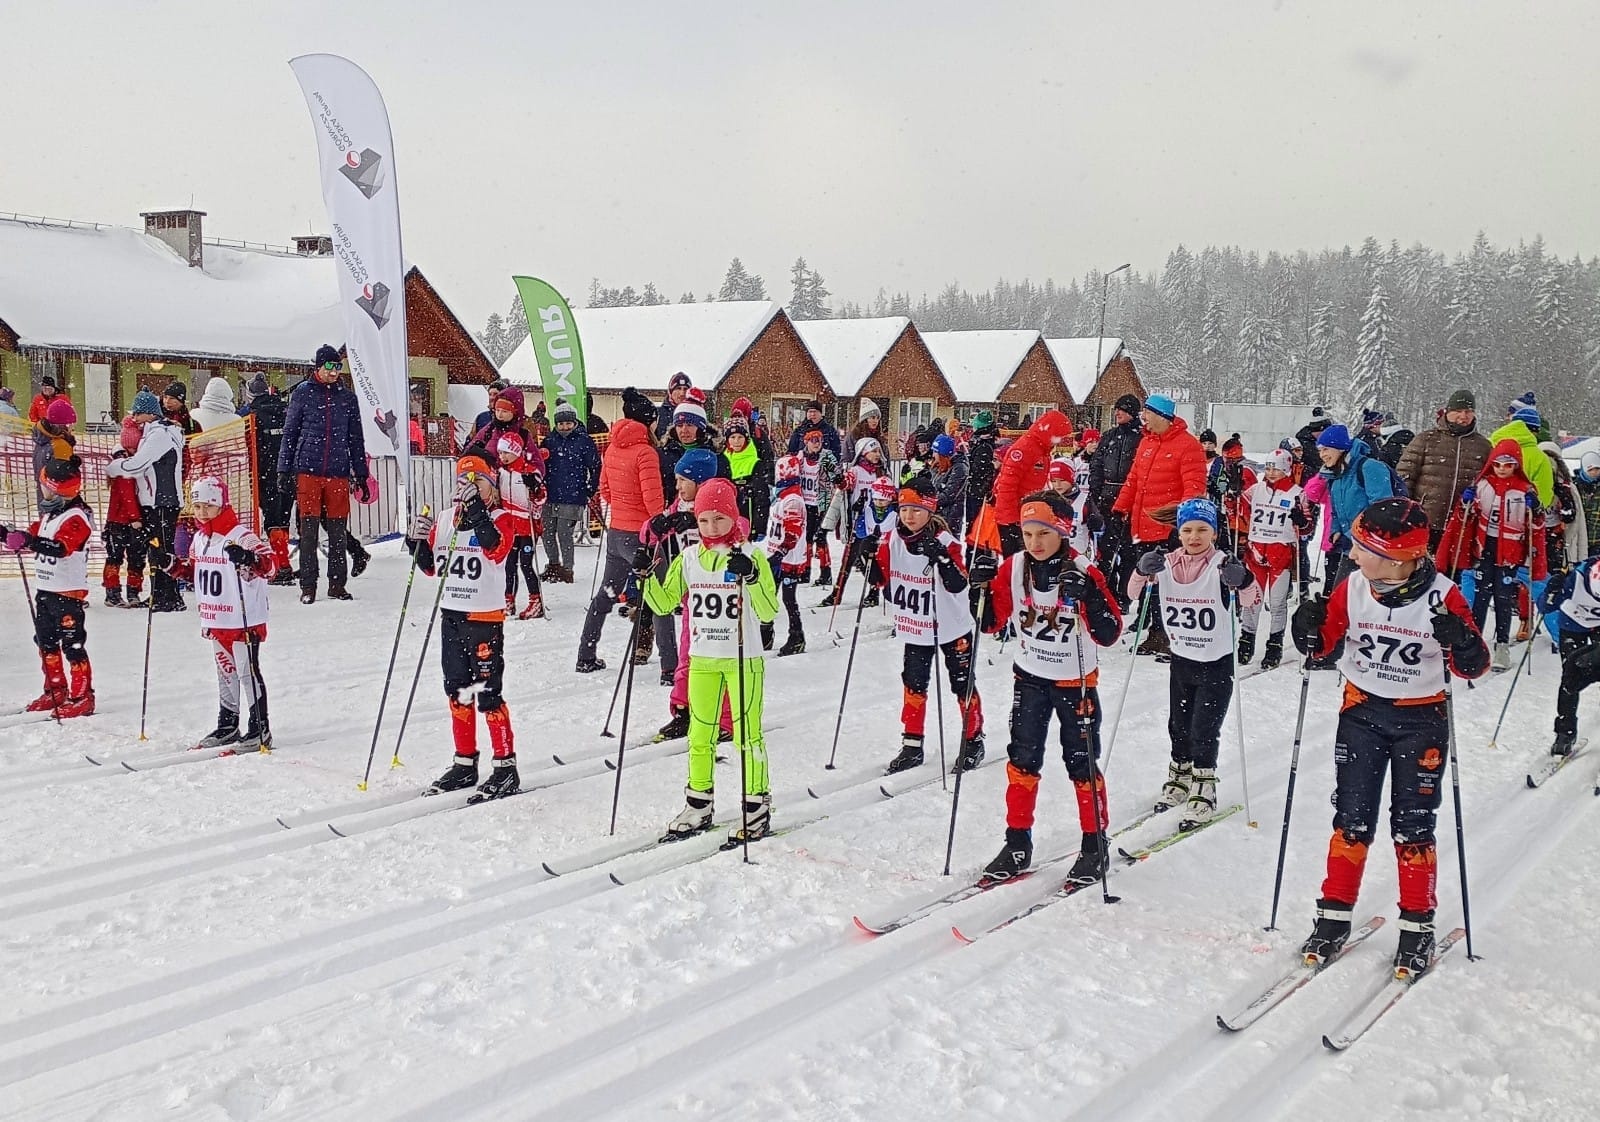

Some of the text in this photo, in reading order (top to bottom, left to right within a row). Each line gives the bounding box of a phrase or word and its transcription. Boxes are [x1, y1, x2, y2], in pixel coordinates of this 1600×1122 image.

[1253, 508, 1288, 527] 211
[436, 554, 482, 581] 249
[692, 593, 738, 620] 298
[893, 584, 931, 616] 441
[1166, 605, 1216, 632] 230
[1376, 672, 1410, 684] BRUCLIK
